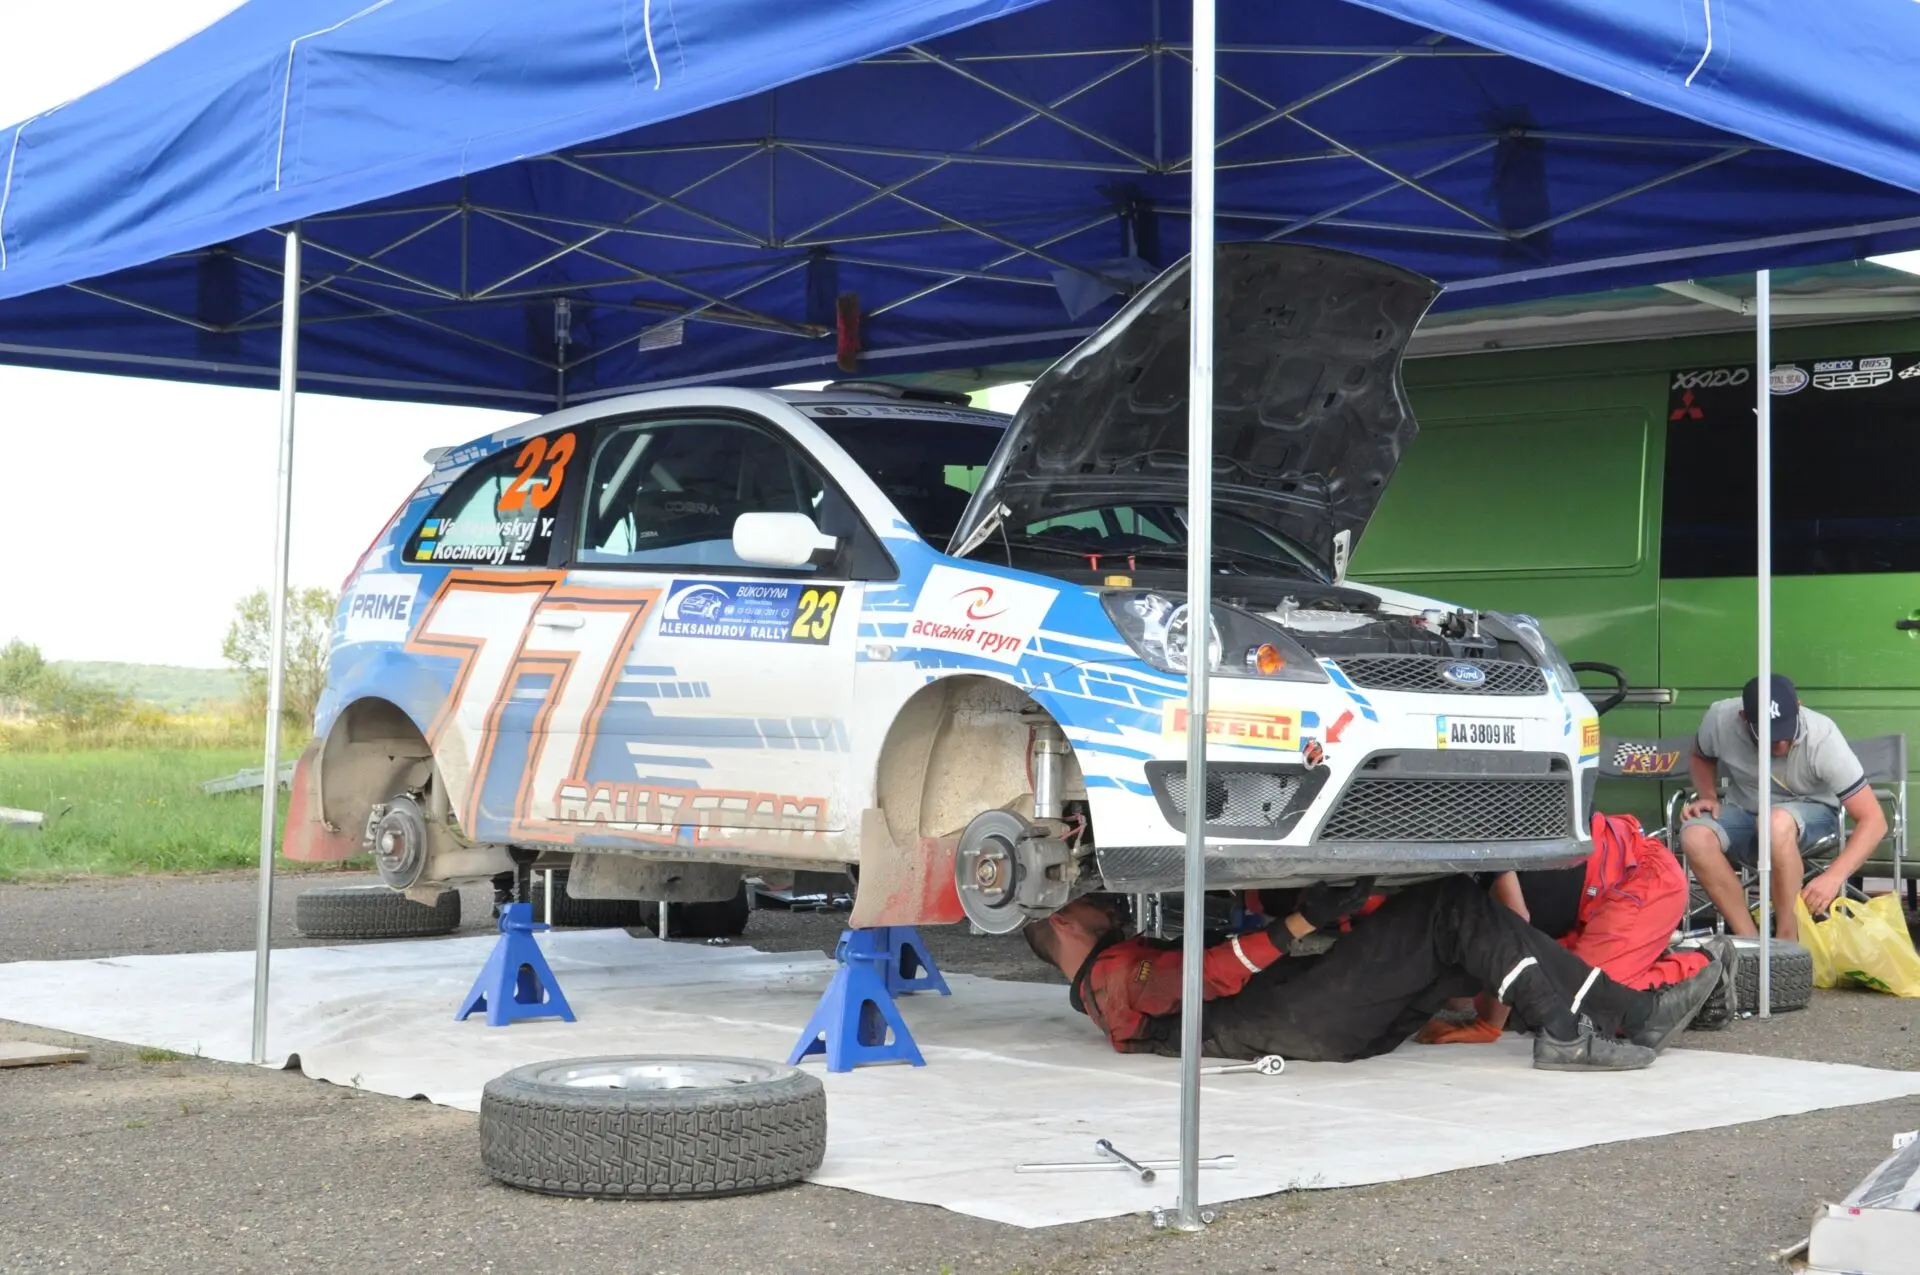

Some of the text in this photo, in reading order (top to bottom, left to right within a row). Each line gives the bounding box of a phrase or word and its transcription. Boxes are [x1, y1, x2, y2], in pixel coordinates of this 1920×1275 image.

[1672, 368, 1749, 390] XADO
[497, 432, 576, 512] 23
[540, 517, 555, 537] Y.
[432, 541, 526, 565] Kochkovyj E.
[736, 586, 789, 599] BUKOVYNA
[351, 594, 411, 620] PRIME
[791, 589, 837, 640] 23
[659, 622, 789, 640] ALEKSANDROV RALLY
[912, 619, 1022, 653] асканія груп
[1455, 664, 1479, 680] Ford
[1173, 708, 1292, 741] PRELLI
[1451, 723, 1467, 742] AA
[1470, 723, 1500, 744] 3809
[557, 780, 824, 841] RALLY TEAM
